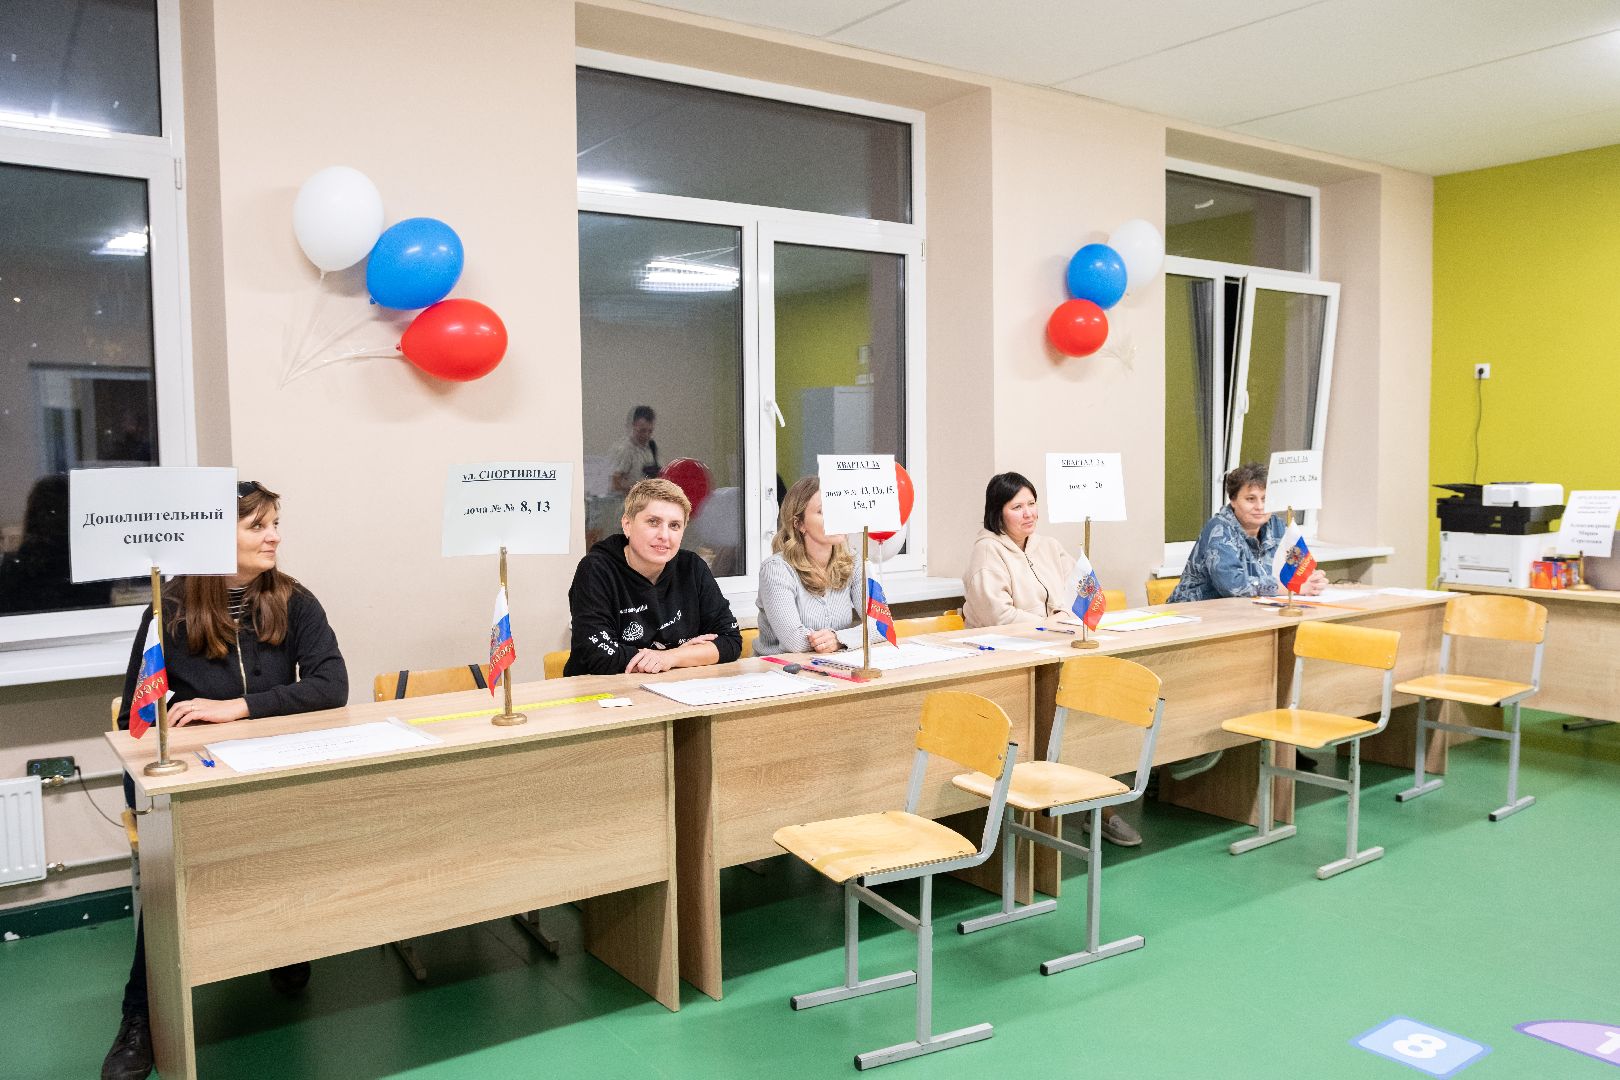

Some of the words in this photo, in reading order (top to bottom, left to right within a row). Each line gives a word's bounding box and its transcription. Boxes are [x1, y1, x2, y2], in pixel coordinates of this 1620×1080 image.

[479, 470, 556, 479] СПОРТИВНАЯ
[520, 501, 532, 514] 8,
[537, 500, 550, 512] 13
[83, 509, 223, 528] Дополнительный
[124, 532, 184, 544] список
[1393, 1033, 1447, 1059] 8
